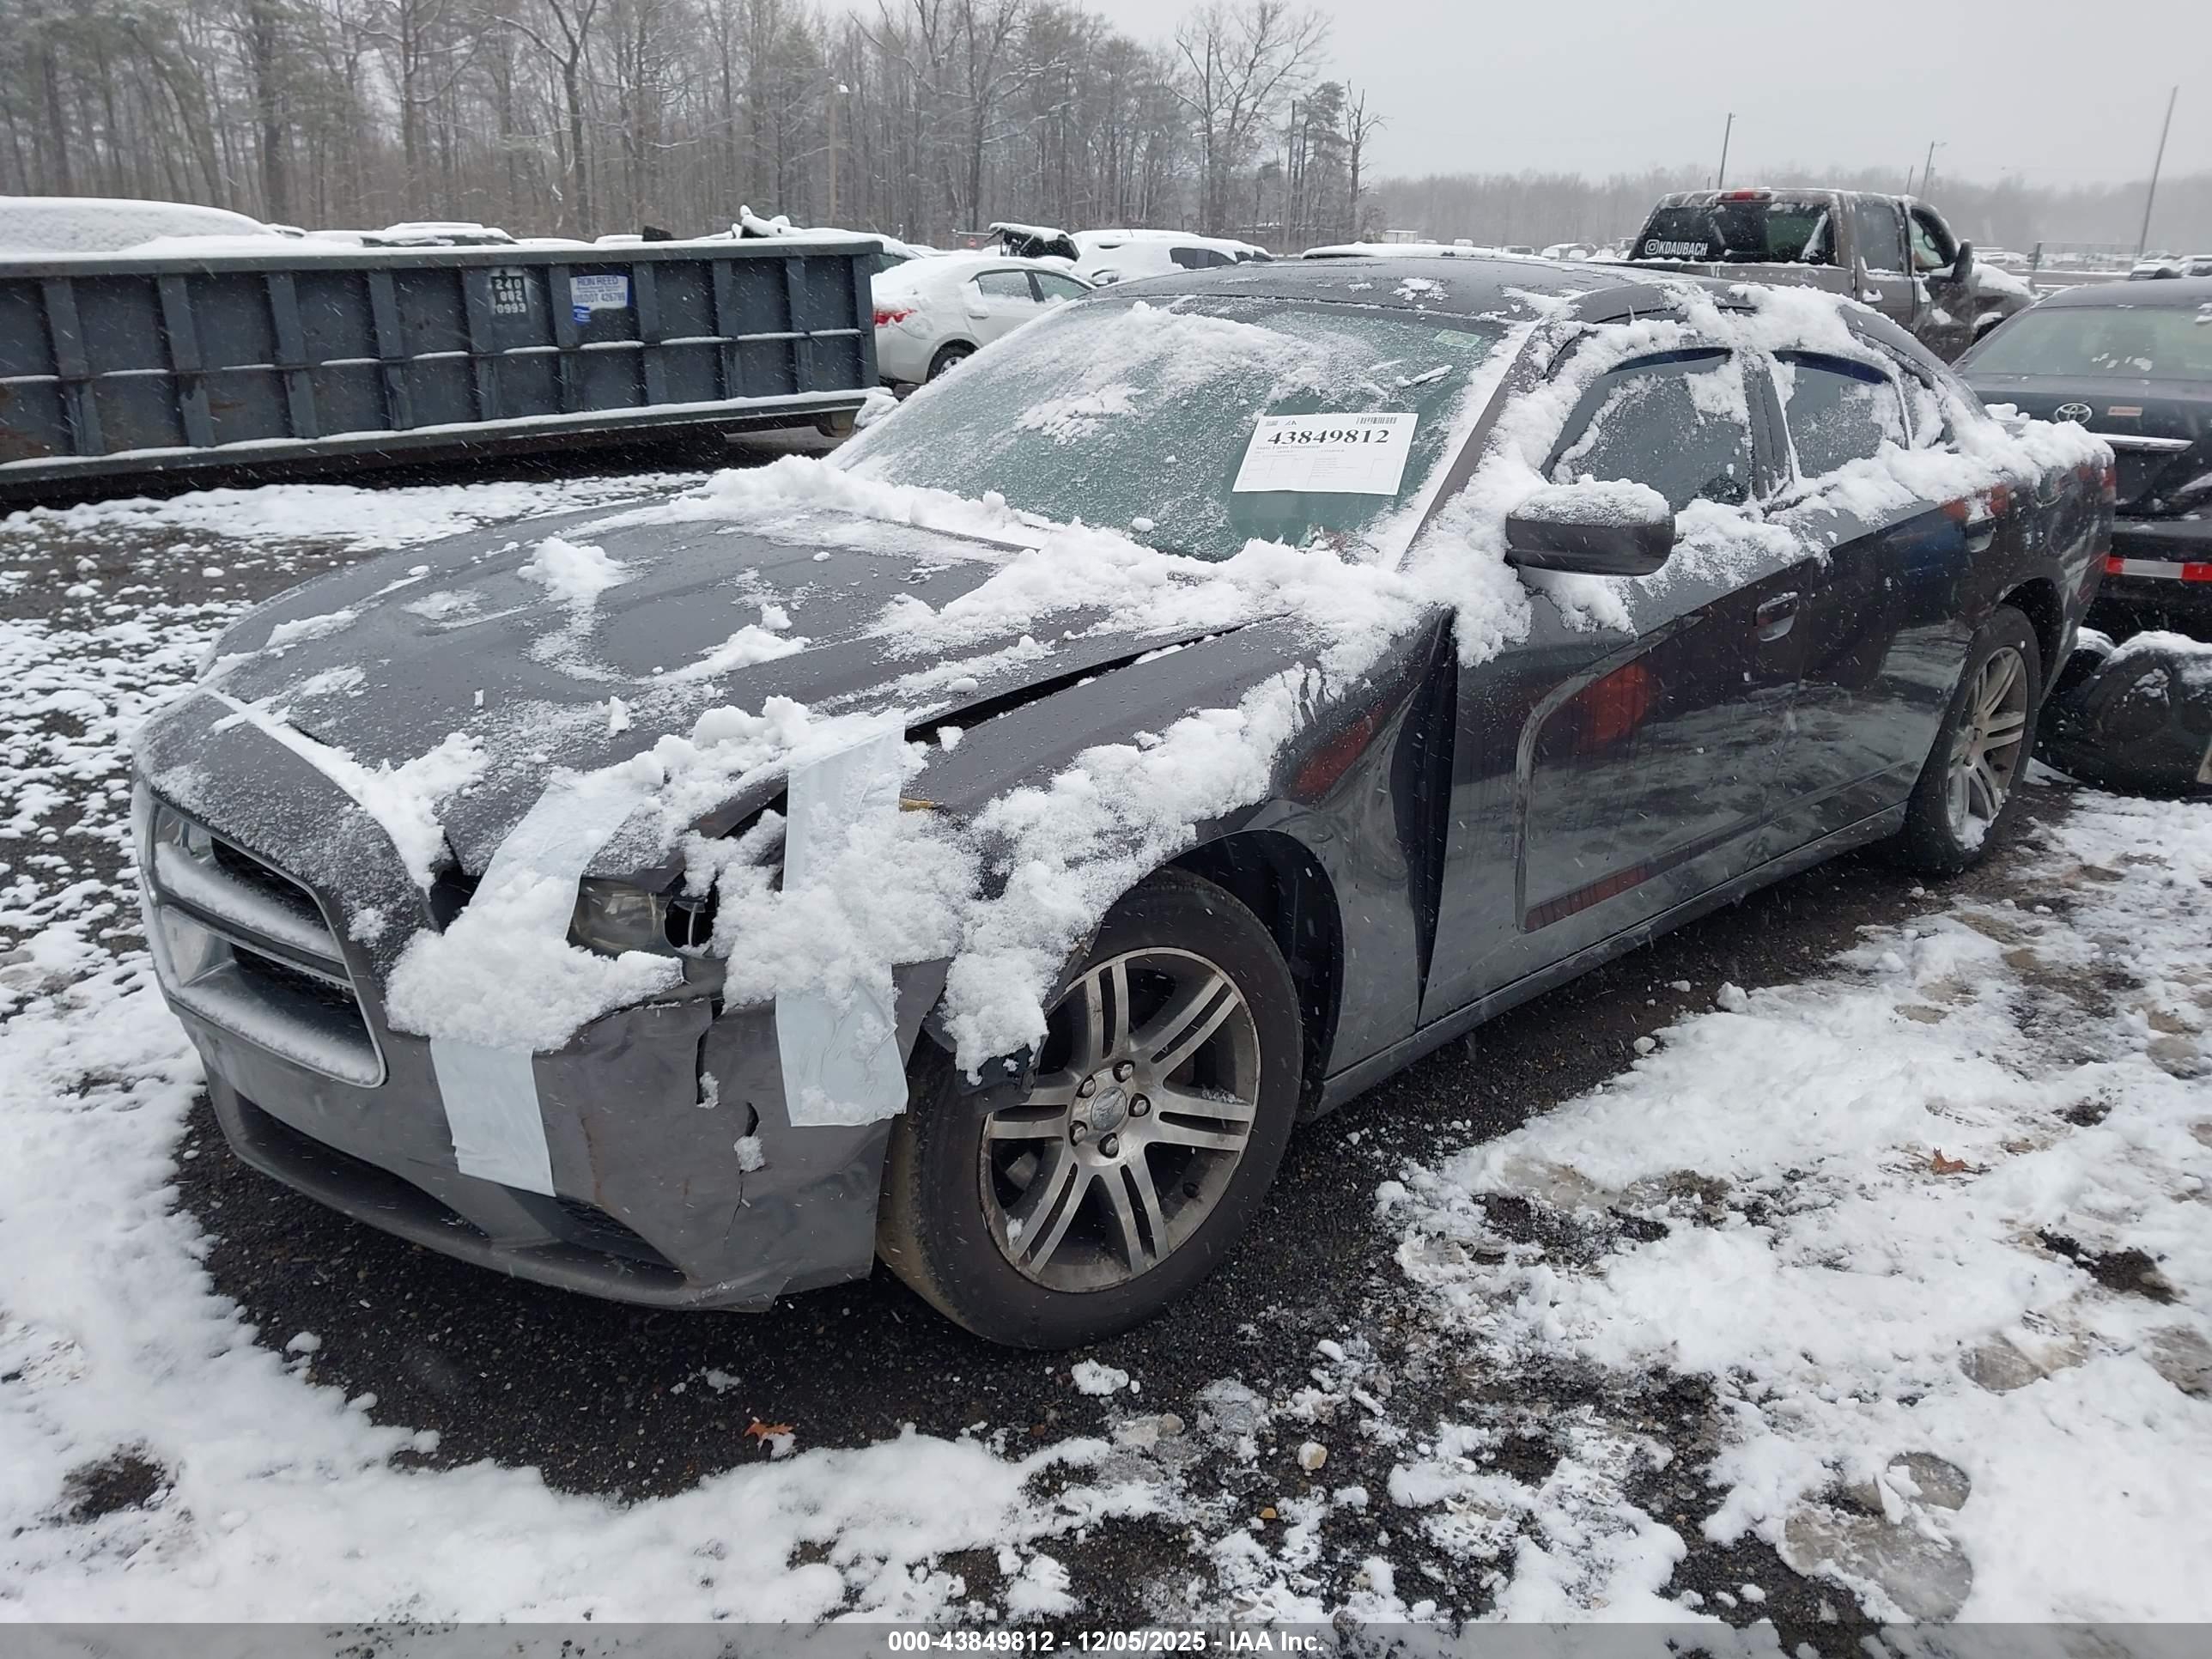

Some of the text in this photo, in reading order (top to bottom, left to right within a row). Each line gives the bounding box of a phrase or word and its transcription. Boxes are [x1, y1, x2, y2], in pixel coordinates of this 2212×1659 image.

[1658, 241, 1709, 256] KDAUBACH
[495, 279, 522, 289] 240
[597, 276, 619, 286] REED
[496, 303, 526, 313] 0993
[1267, 429, 1389, 445] 43849812
